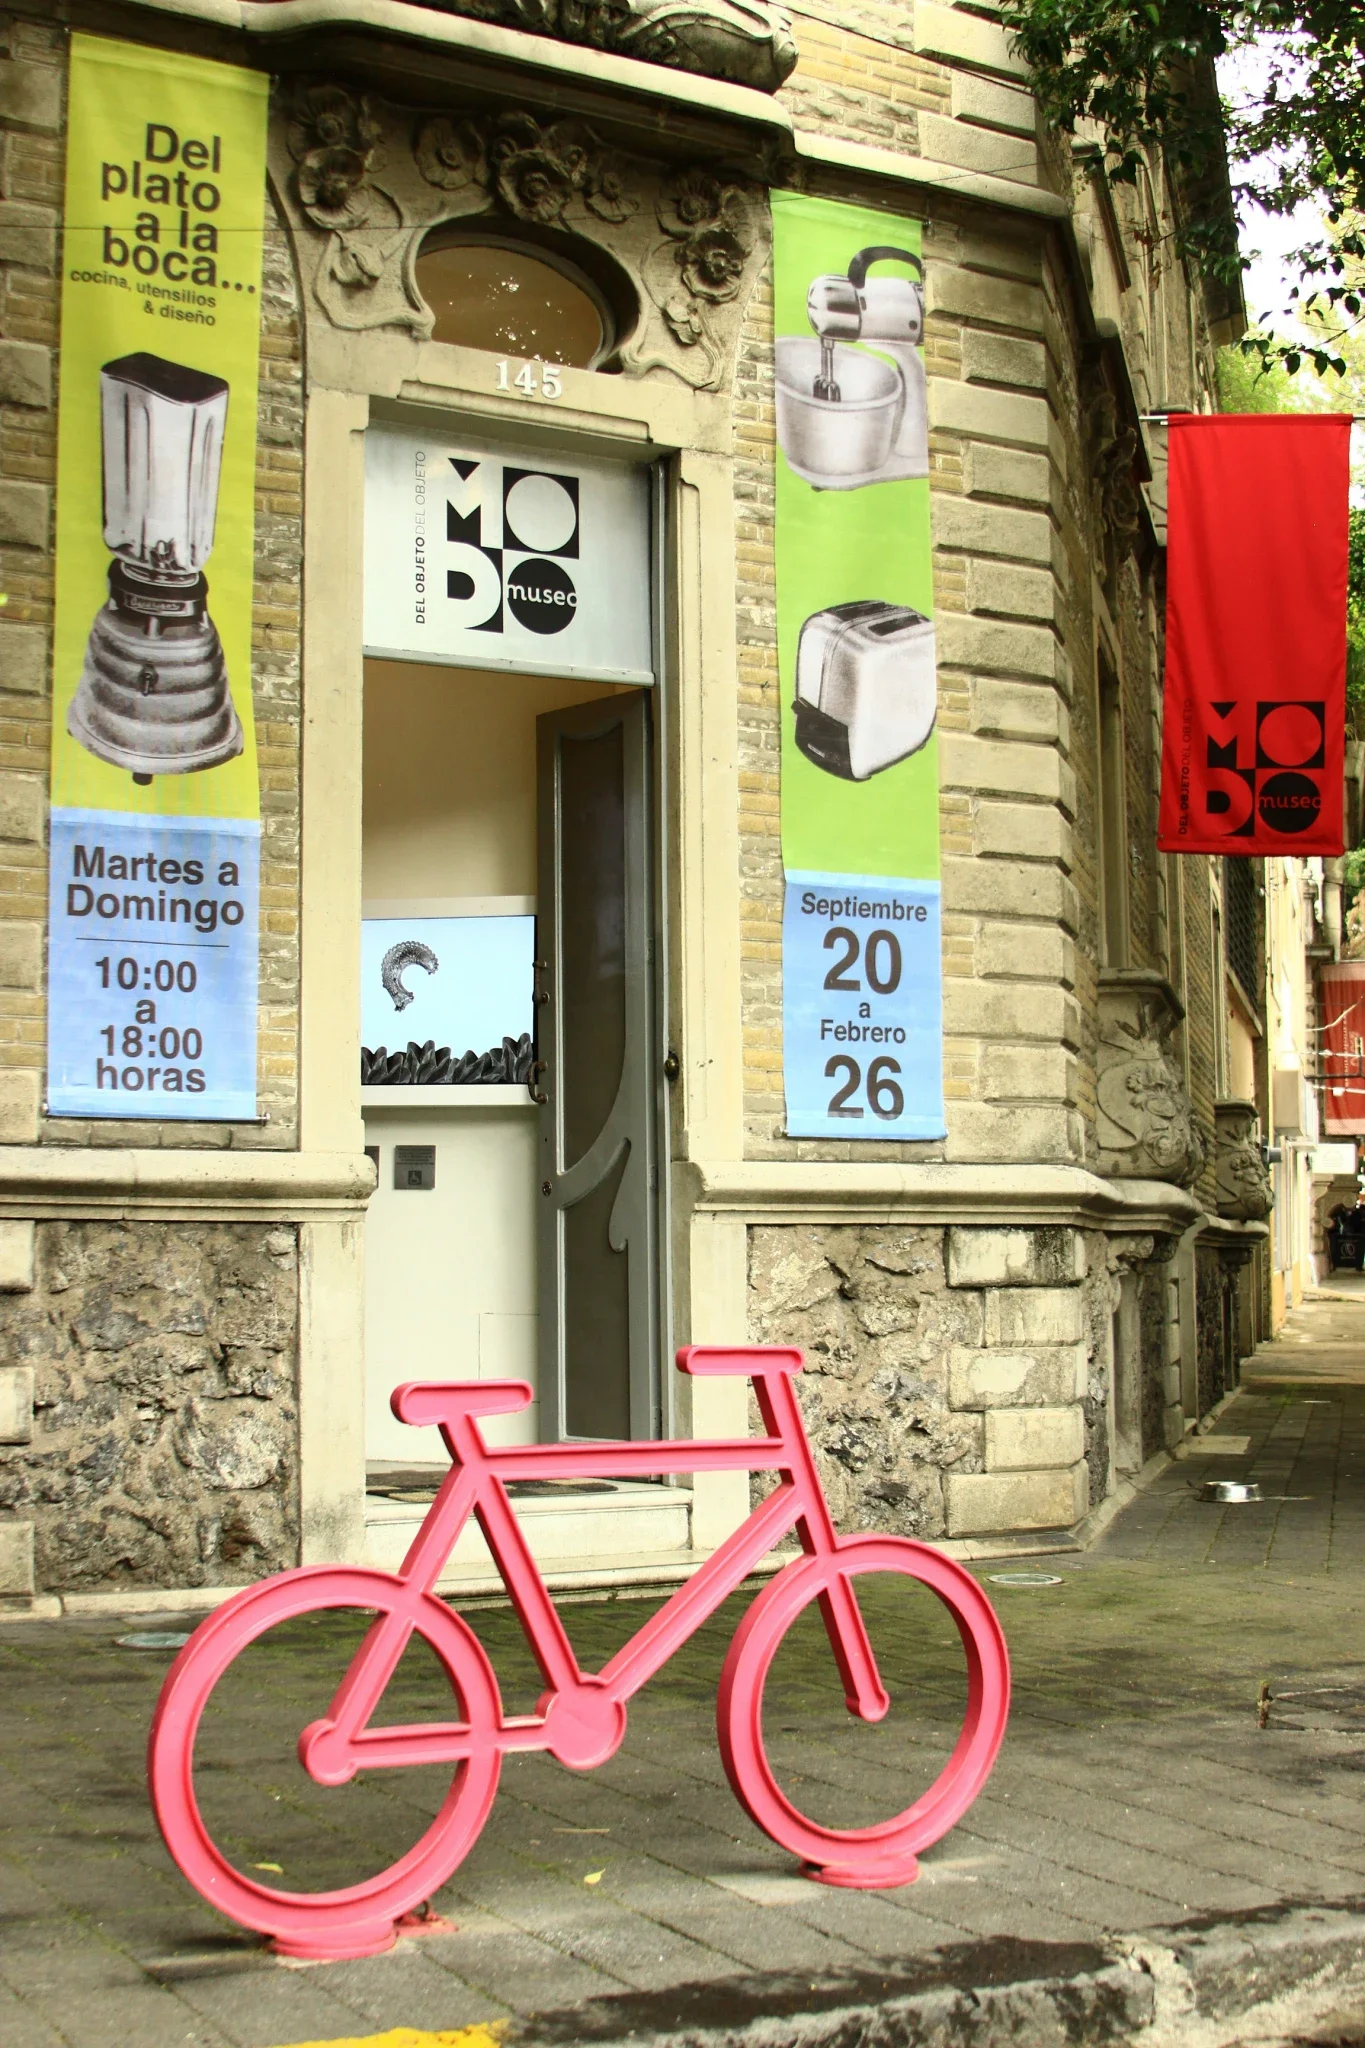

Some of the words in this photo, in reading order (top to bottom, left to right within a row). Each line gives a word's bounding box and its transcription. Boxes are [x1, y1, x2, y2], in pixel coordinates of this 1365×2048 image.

[145, 123, 221, 173] Del
[102, 161, 221, 213] plato
[135, 212, 160, 244] a
[179, 211, 218, 254] la
[103, 226, 256, 294] boca...
[70, 269, 132, 293] cocina,
[137, 282, 216, 308] utensilios
[143, 301, 155, 316] &
[160, 304, 216, 327] diseño
[496, 360, 562, 399] 145
[415, 451, 426, 505] OBJETO
[415, 537, 426, 593] OBJETO
[415, 597, 426, 624] DEL
[507, 583, 578, 608] museo
[1258, 795, 1321, 809] museo
[1178, 812, 1189, 835] DEL
[73, 844, 204, 886] Martes
[218, 861, 239, 887] a
[66, 883, 244, 933] Domingo
[801, 892, 927, 922] Septiembre
[95, 956, 197, 993] 10:00
[823, 926, 902, 995] 20
[135, 999, 156, 1024] a
[859, 1002, 871, 1018] a
[100, 1025, 202, 1060] 18:00
[820, 1019, 906, 1044] Febrero
[97, 1057, 206, 1092] horas
[824, 1054, 905, 1121] 26
